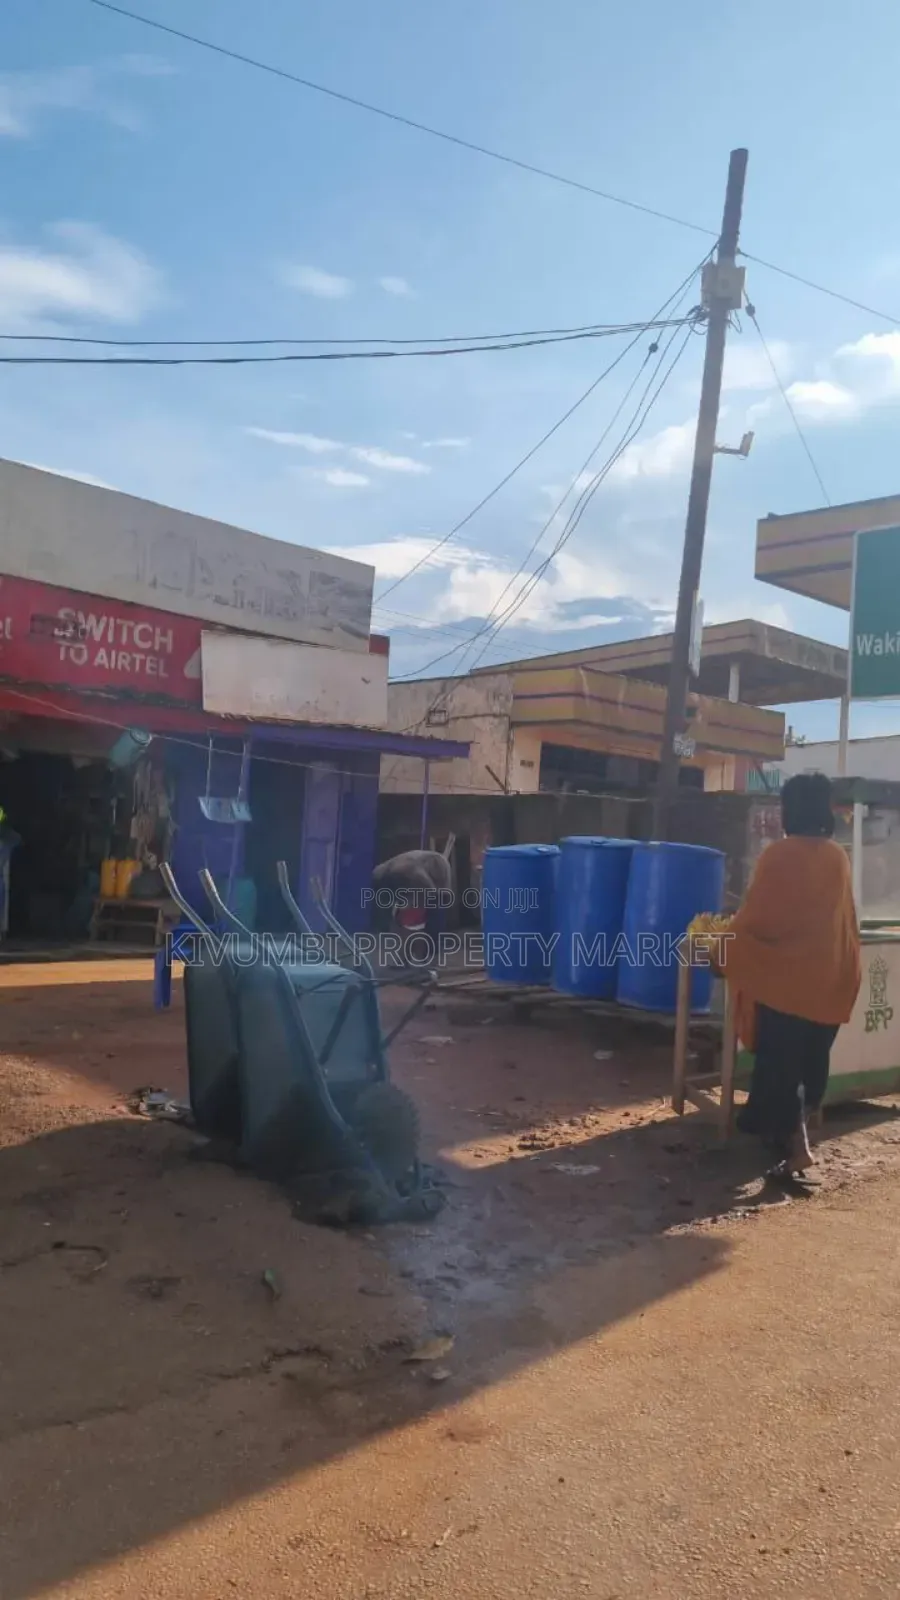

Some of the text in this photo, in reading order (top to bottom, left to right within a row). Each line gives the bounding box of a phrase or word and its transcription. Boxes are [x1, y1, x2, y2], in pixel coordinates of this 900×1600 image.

[56, 606, 174, 654] SWITCH
[56, 640, 89, 666] TO
[93, 647, 170, 679] AIRTEL
